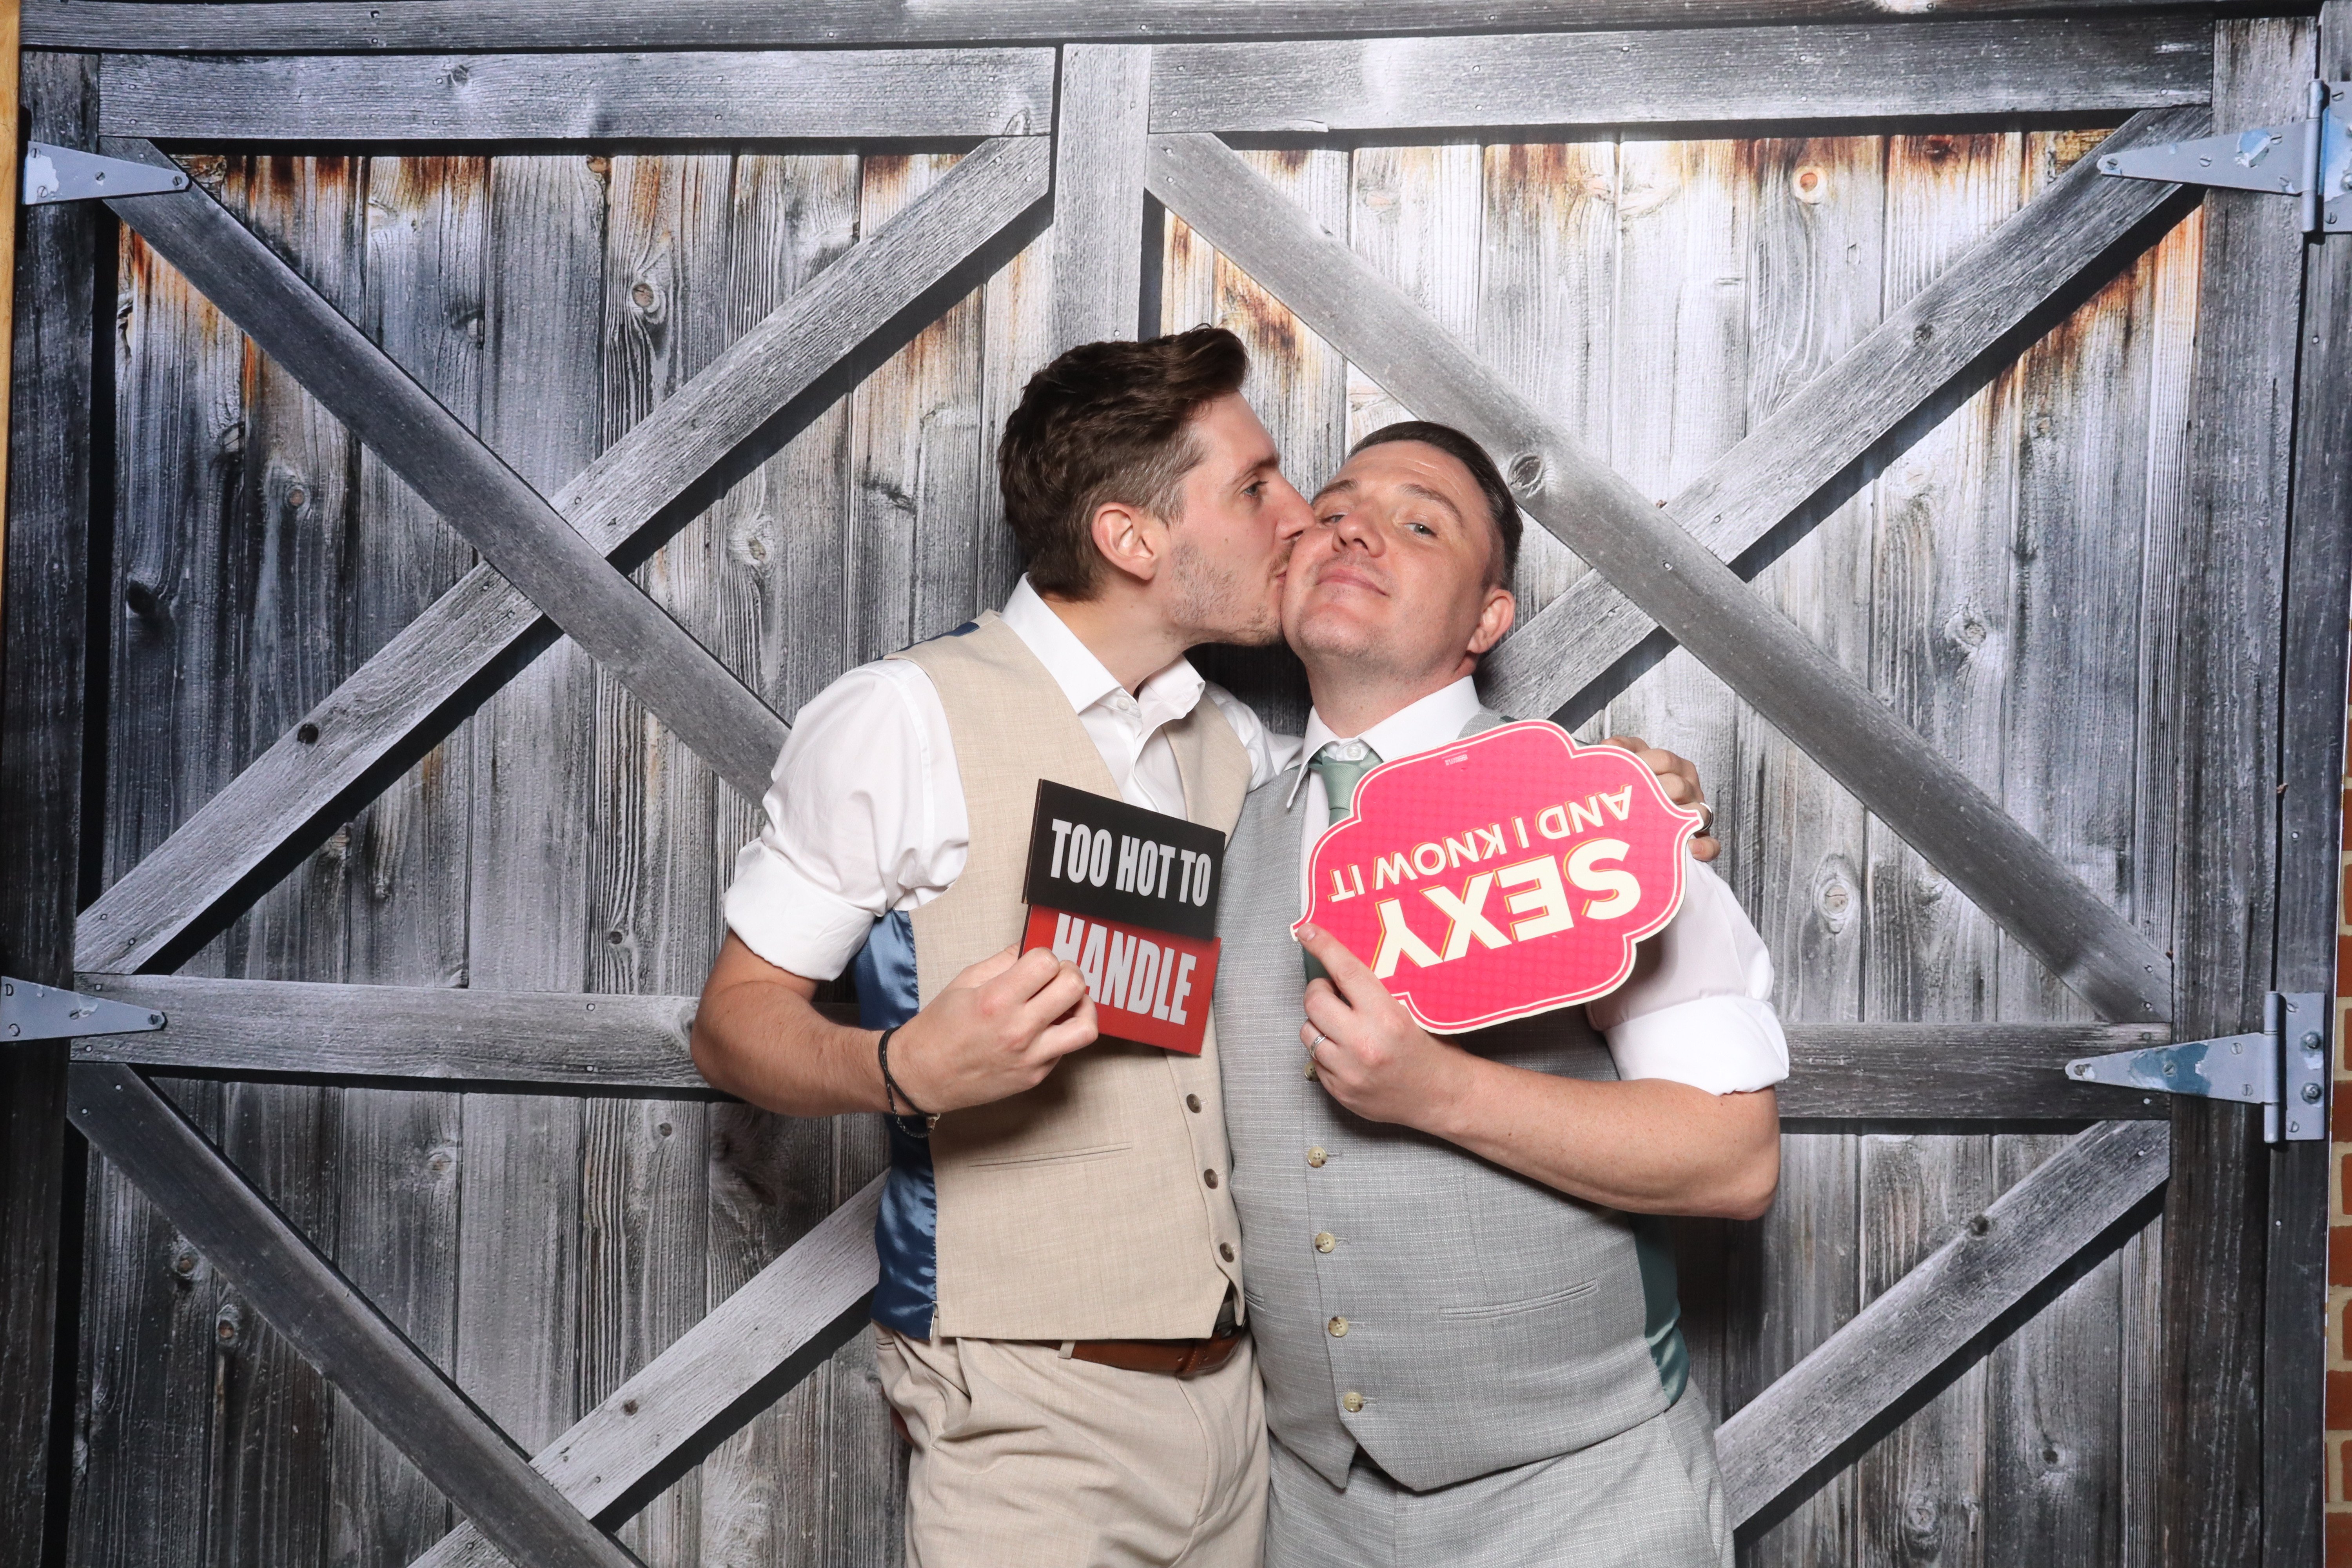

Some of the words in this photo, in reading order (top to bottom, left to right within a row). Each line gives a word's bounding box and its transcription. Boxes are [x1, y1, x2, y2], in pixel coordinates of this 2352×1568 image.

[1512, 817, 1530, 849] I
[1537, 784, 1633, 840] AND
[1051, 818, 1112, 887] TOO
[1115, 835, 1176, 899] HOT
[1179, 849, 1211, 907] TO
[1328, 864, 1365, 902] IT
[1373, 823, 1507, 890] KNOW
[1371, 837, 1641, 979] SEXY
[1052, 912, 1197, 1025] HANDLE
